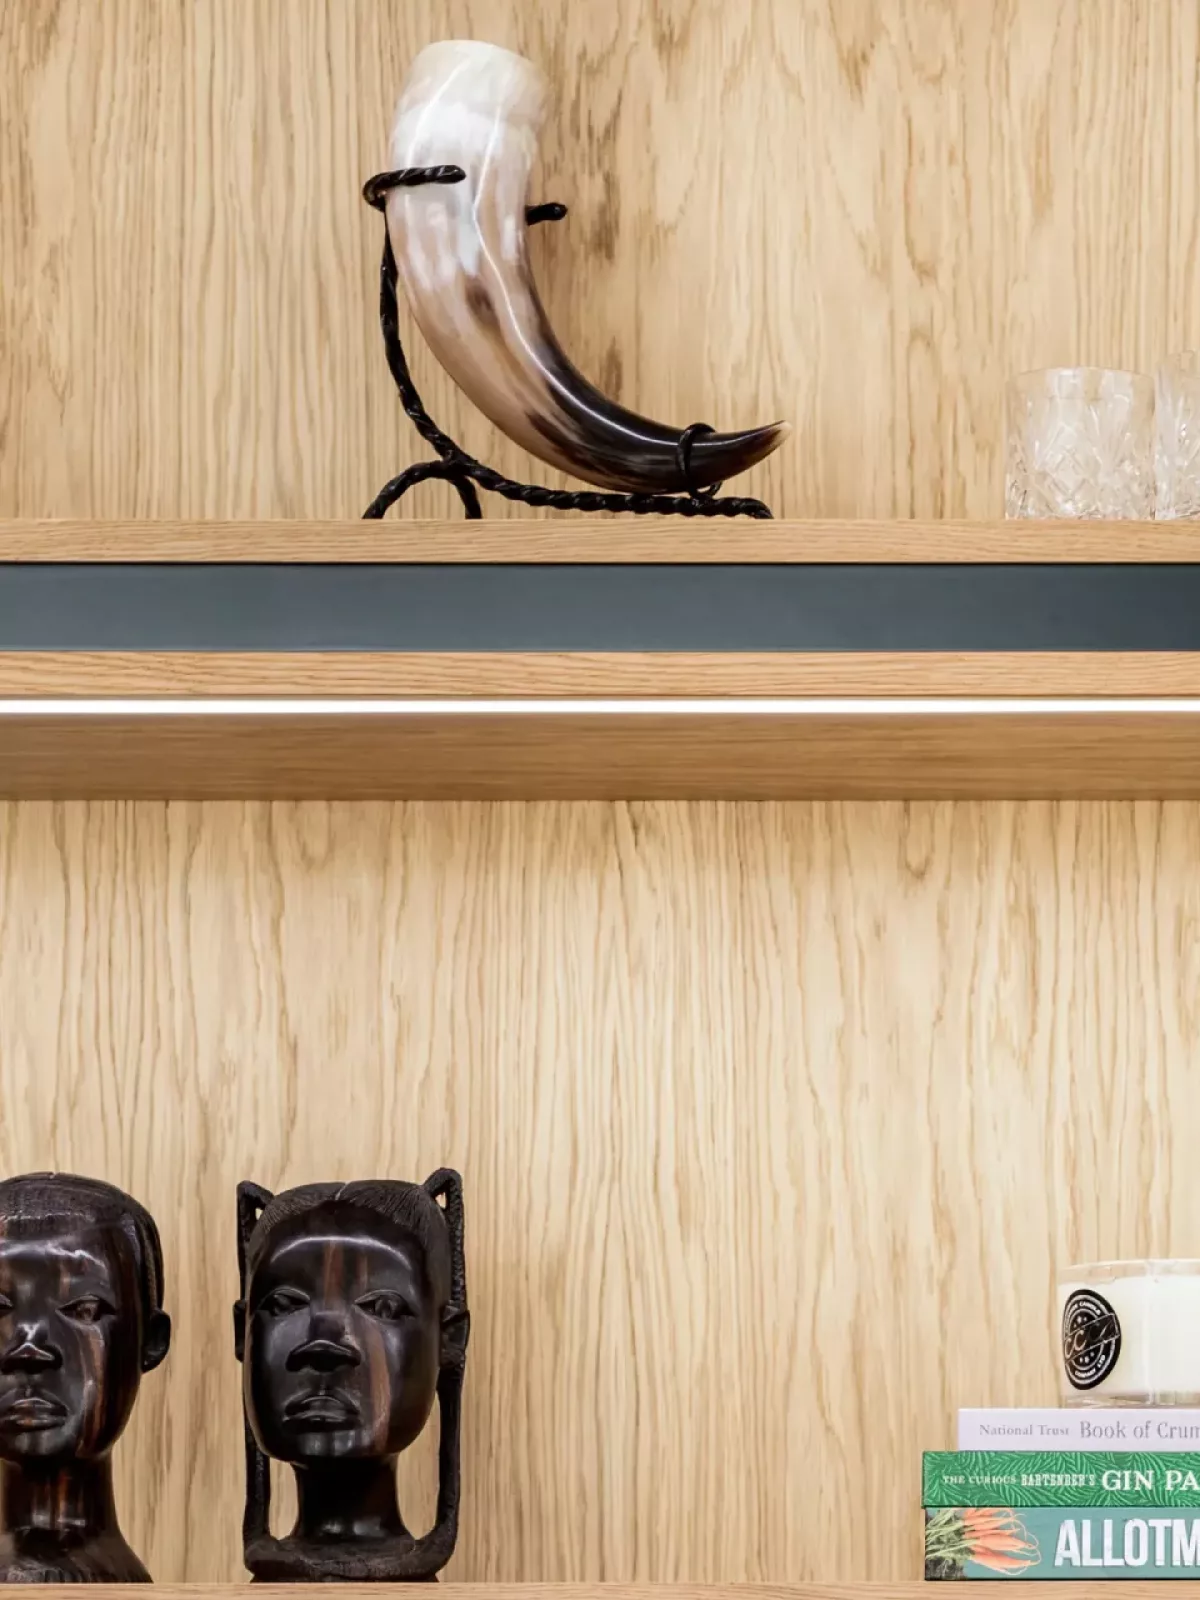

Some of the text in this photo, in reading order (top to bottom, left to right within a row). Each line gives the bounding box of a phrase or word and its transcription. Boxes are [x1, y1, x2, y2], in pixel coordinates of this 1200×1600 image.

[979, 1424, 1033, 1436] National
[1037, 1424, 1070, 1436] Trust
[1080, 1420, 1126, 1439] Book
[1133, 1420, 1151, 1439] of
[943, 1475, 965, 1485] THE
[969, 1474, 1016, 1485] CURIOUS
[1021, 1474, 1095, 1486] BARTENDER'S
[1102, 1469, 1155, 1491] GIN
